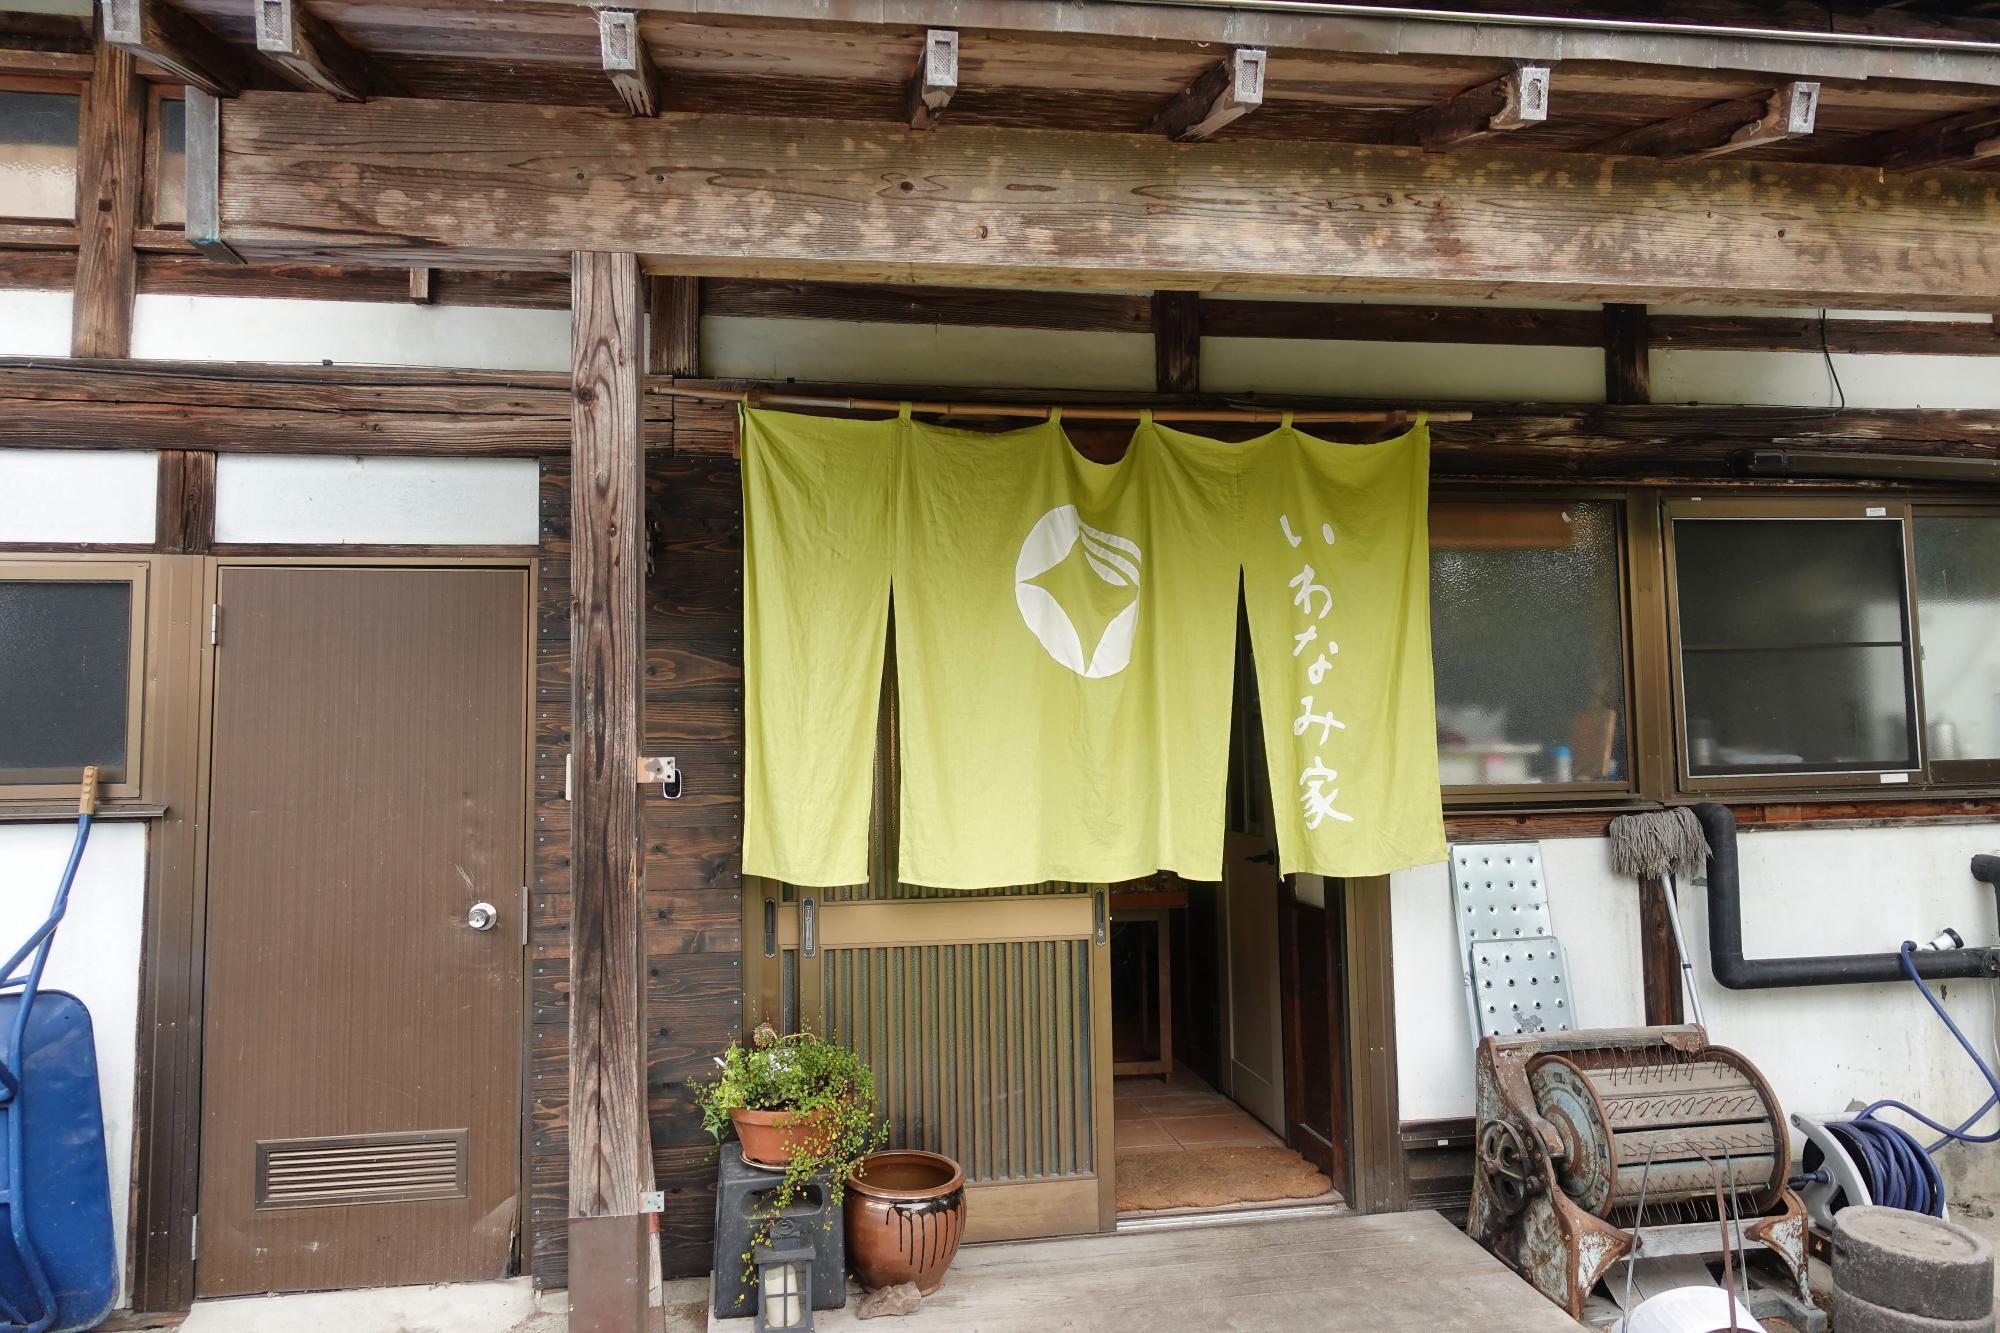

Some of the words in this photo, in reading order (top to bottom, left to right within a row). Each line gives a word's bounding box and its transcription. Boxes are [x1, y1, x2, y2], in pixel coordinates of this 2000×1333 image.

[1279, 514, 1354, 830] いわなみ家
